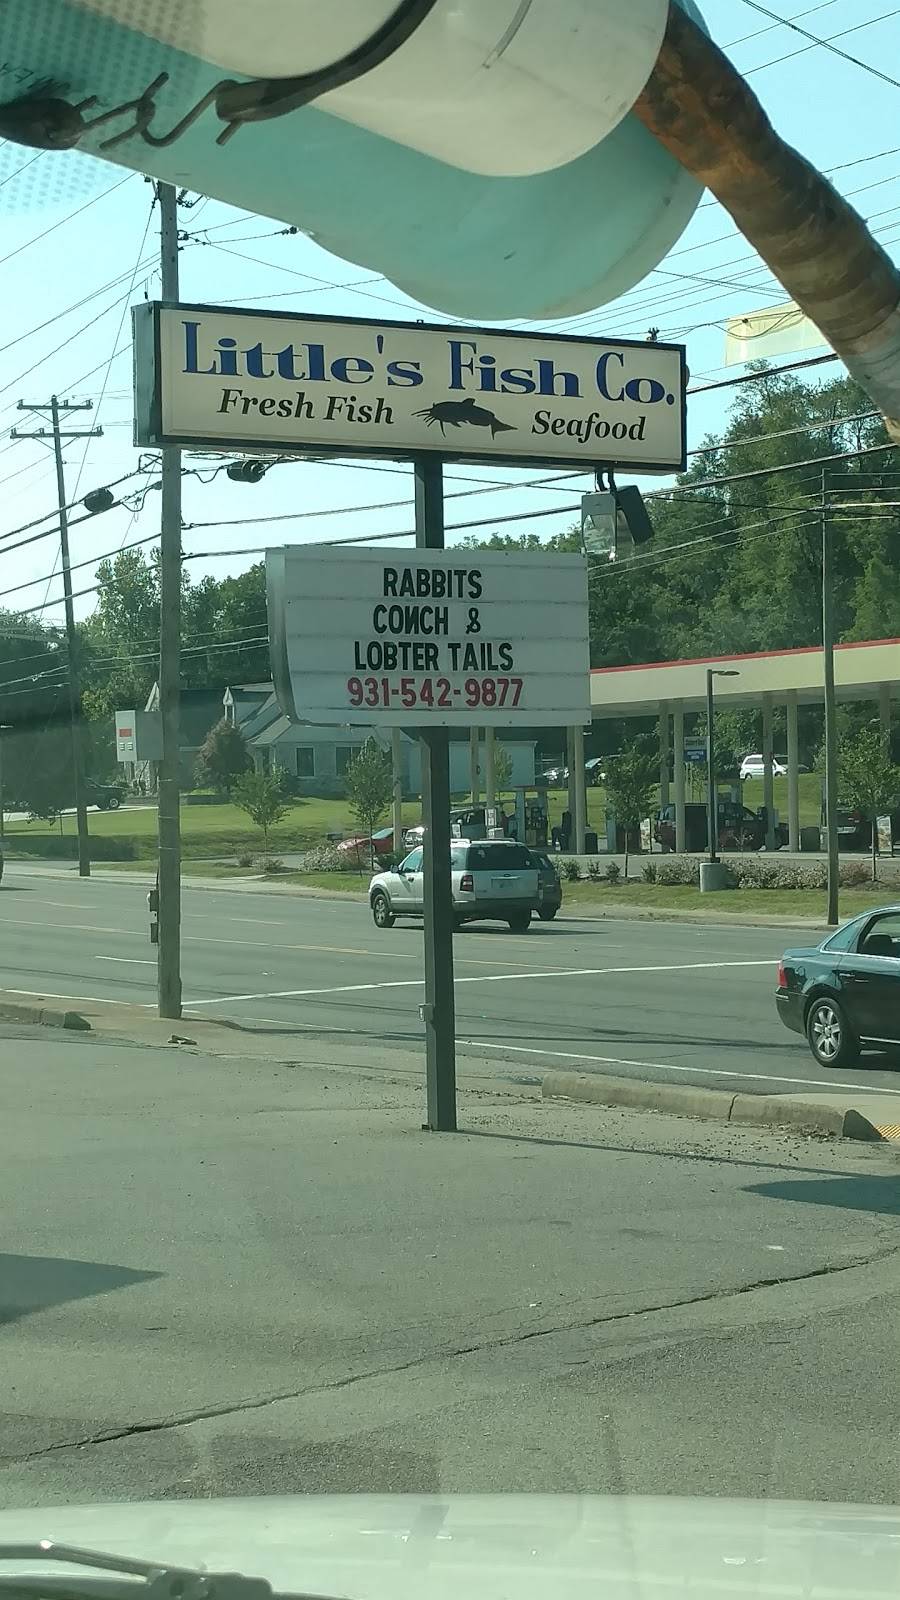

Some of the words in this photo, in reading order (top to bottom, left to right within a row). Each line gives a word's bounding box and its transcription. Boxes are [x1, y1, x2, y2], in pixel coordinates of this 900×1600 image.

[181, 320, 424, 388] Little's
[447, 339, 585, 399] Fish
[595, 351, 676, 406] Co.
[216, 388, 315, 419] Fresh
[322, 395, 394, 425] Fish
[530, 409, 647, 443] Seafood
[383, 567, 483, 599] RABBITS
[373, 604, 449, 635] CONCH
[465, 607, 481, 635] &
[354, 640, 439, 671] LOBTER
[447, 642, 514, 671] TAILS
[347, 677, 524, 708] 931-542-9877
